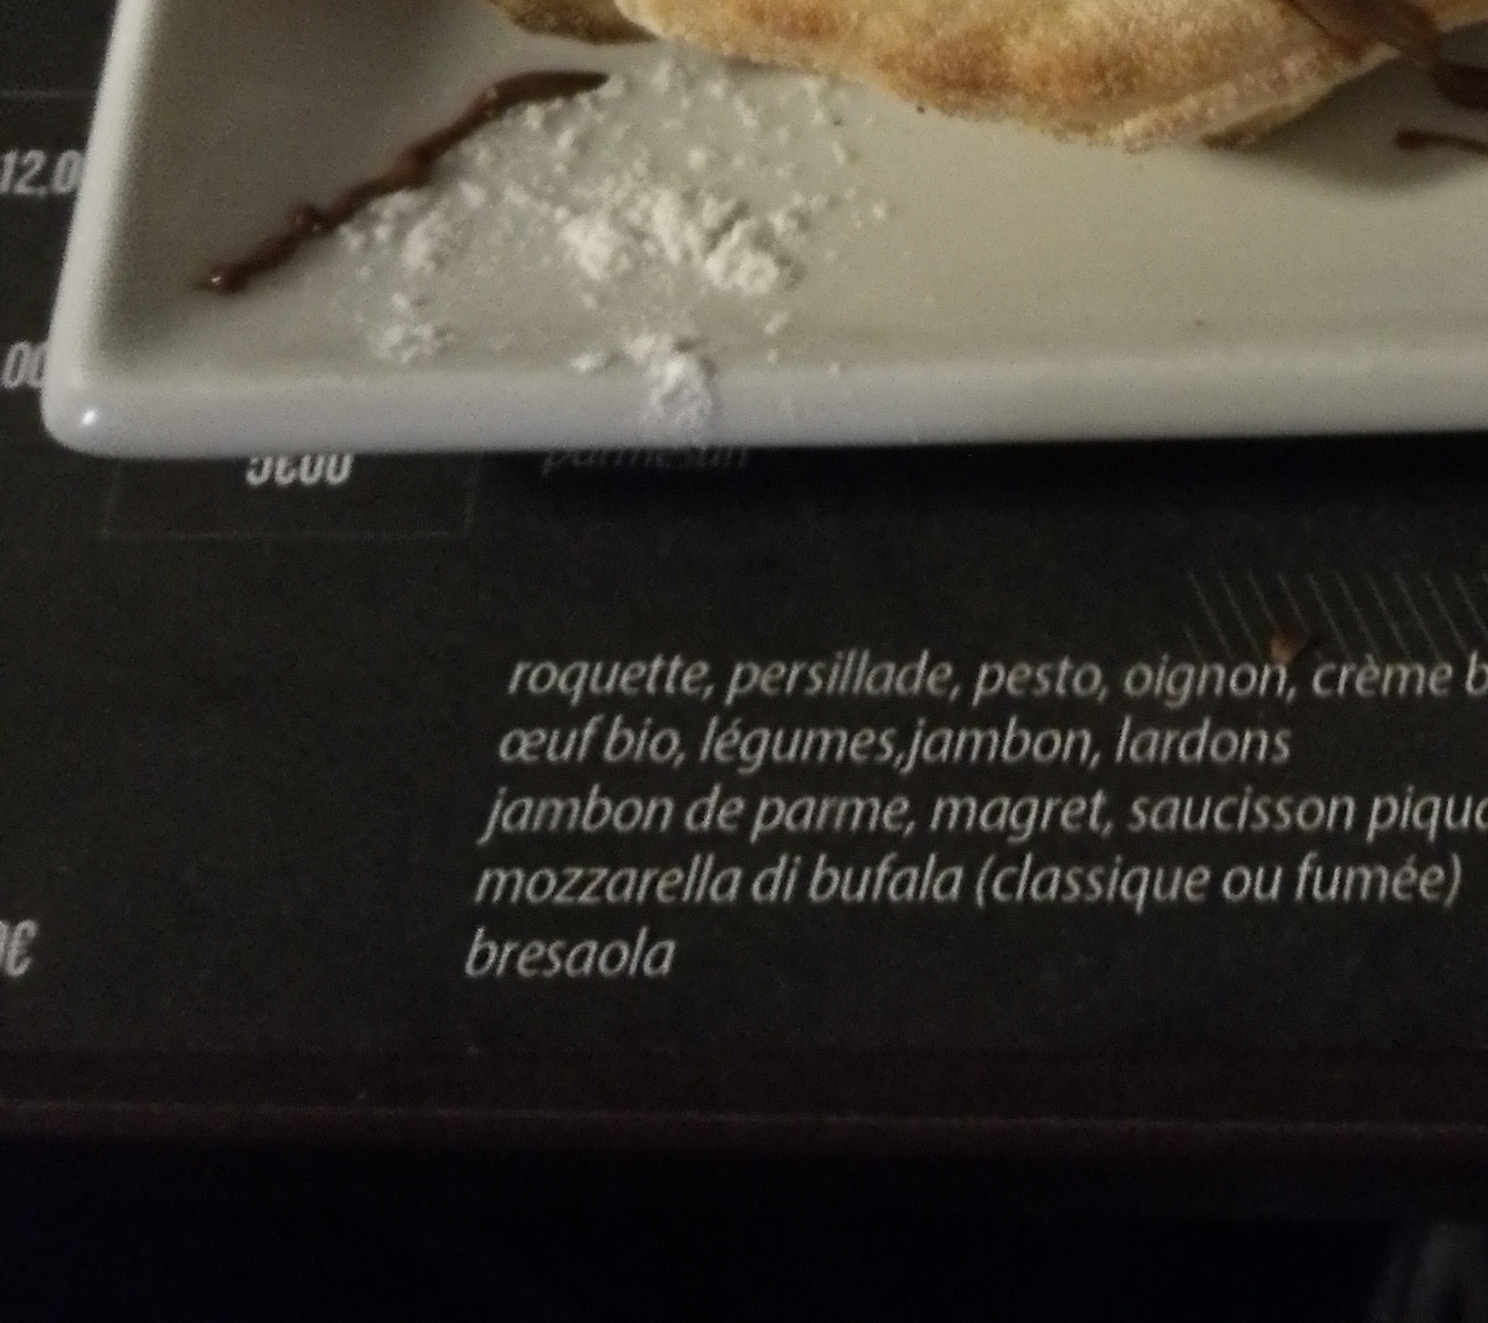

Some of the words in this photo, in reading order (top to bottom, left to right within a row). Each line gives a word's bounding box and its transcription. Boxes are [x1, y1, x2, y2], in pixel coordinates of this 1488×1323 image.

[506, 654, 716, 707] roquette,
[725, 649, 962, 707] persillade,
[971, 658, 1110, 708] pesto,
[1122, 656, 1298, 710] oignon,
[1311, 653, 1453, 698] crème
[498, 712, 605, 764] œuf
[603, 715, 686, 768] bio,
[1114, 716, 1293, 764] lardons
[475, 784, 676, 847] jambon
[683, 783, 746, 833] de
[750, 792, 918, 844] parme,
[928, 788, 1113, 844] magret,
[1126, 785, 1356, 834] saucisson
[473, 853, 740, 905] mozzarella
[749, 854, 802, 905] di
[806, 852, 964, 904] bufala
[975, 852, 1210, 915] (classique
[1220, 865, 1283, 903] ou
[1294, 850, 1463, 909] fumée)
[464, 927, 678, 978] bresaola
